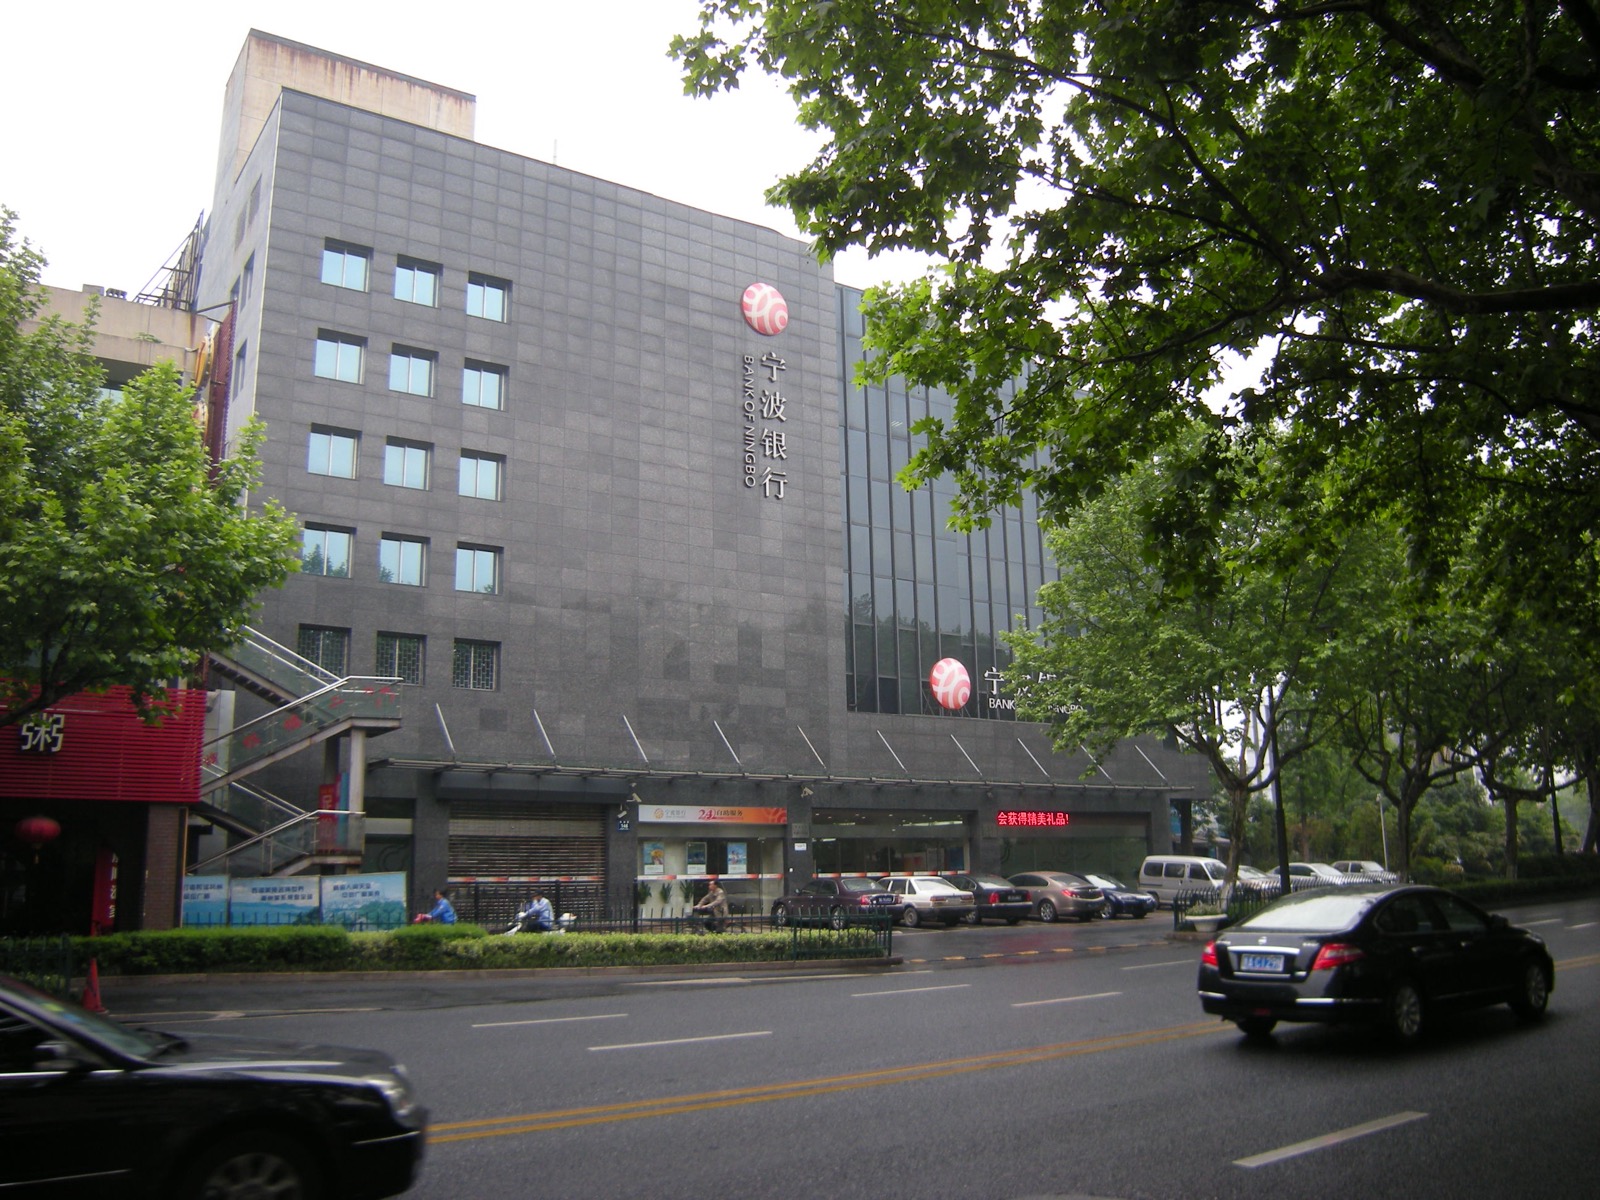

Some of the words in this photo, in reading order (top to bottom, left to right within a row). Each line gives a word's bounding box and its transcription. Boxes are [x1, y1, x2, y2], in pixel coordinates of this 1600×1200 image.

[743, 354, 755, 398] BANK
[743, 401, 756, 423] OF
[760, 351, 788, 499] 宁波银行
[743, 425, 756, 488] NINGBO
[989, 698, 1016, 710] BANK
[20, 712, 65, 753] 粥
